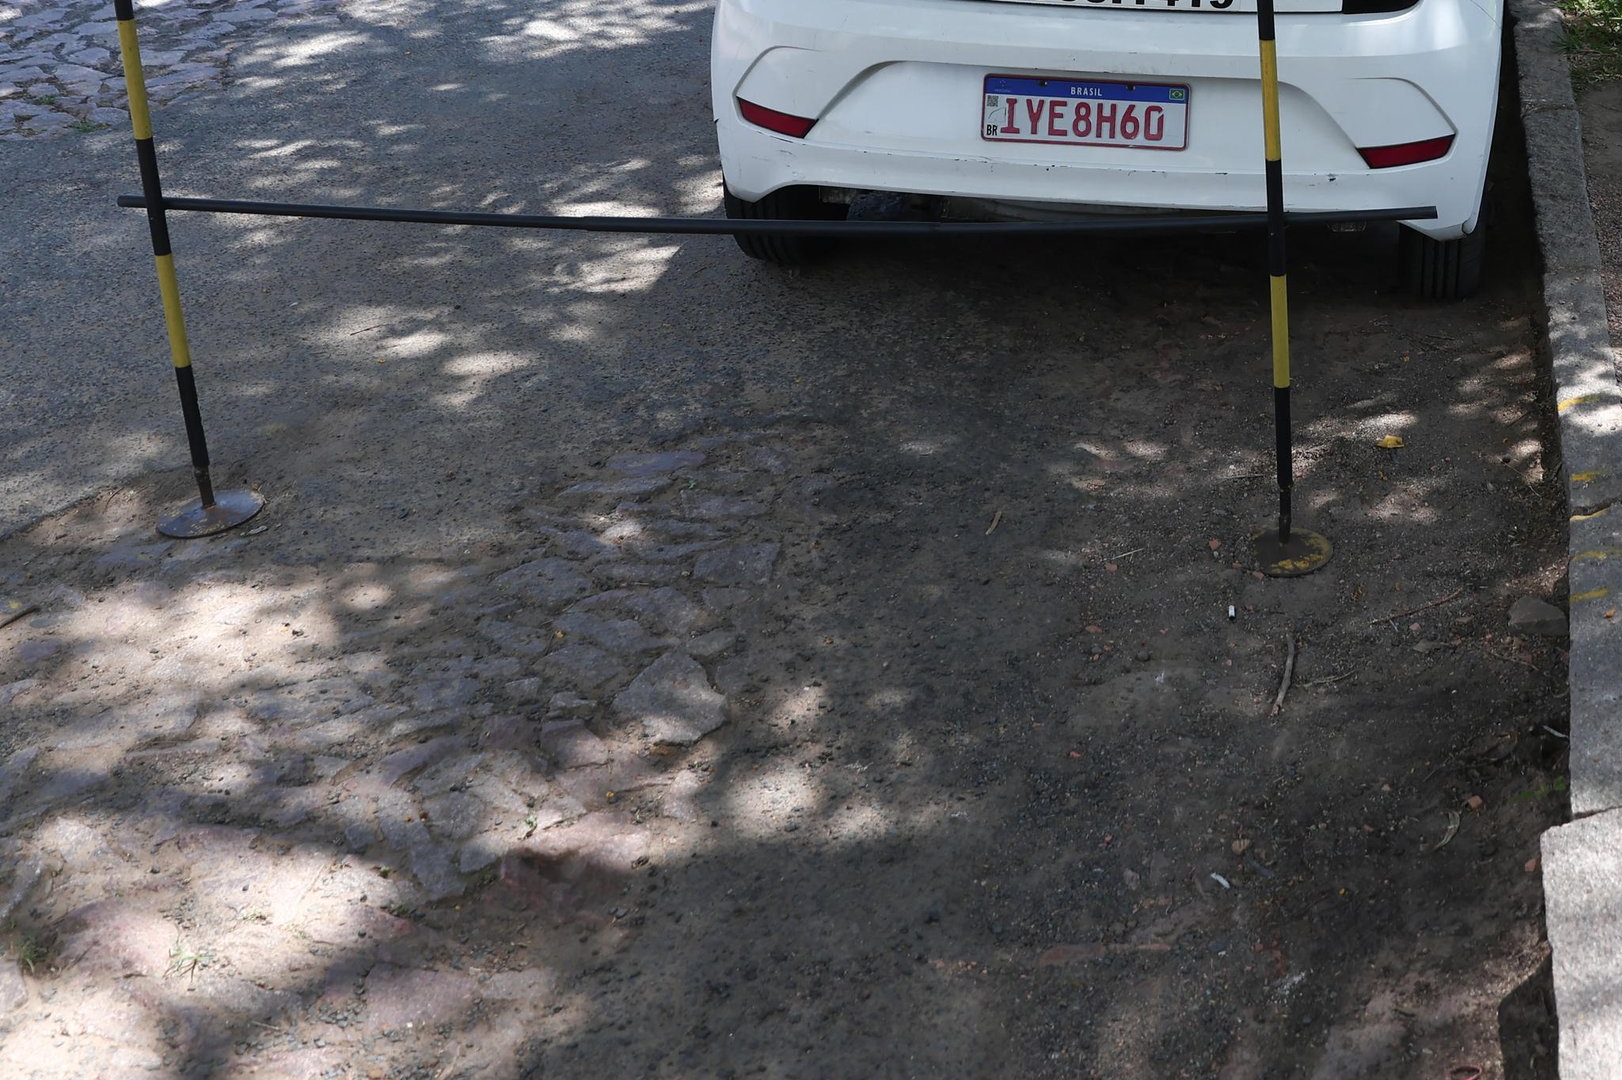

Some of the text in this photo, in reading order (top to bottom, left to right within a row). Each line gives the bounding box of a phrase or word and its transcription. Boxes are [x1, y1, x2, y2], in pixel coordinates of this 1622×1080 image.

[1070, 86, 1103, 97] BRASIL
[1000, 97, 1164, 141] IYE8H60
[986, 124, 998, 136] BR
